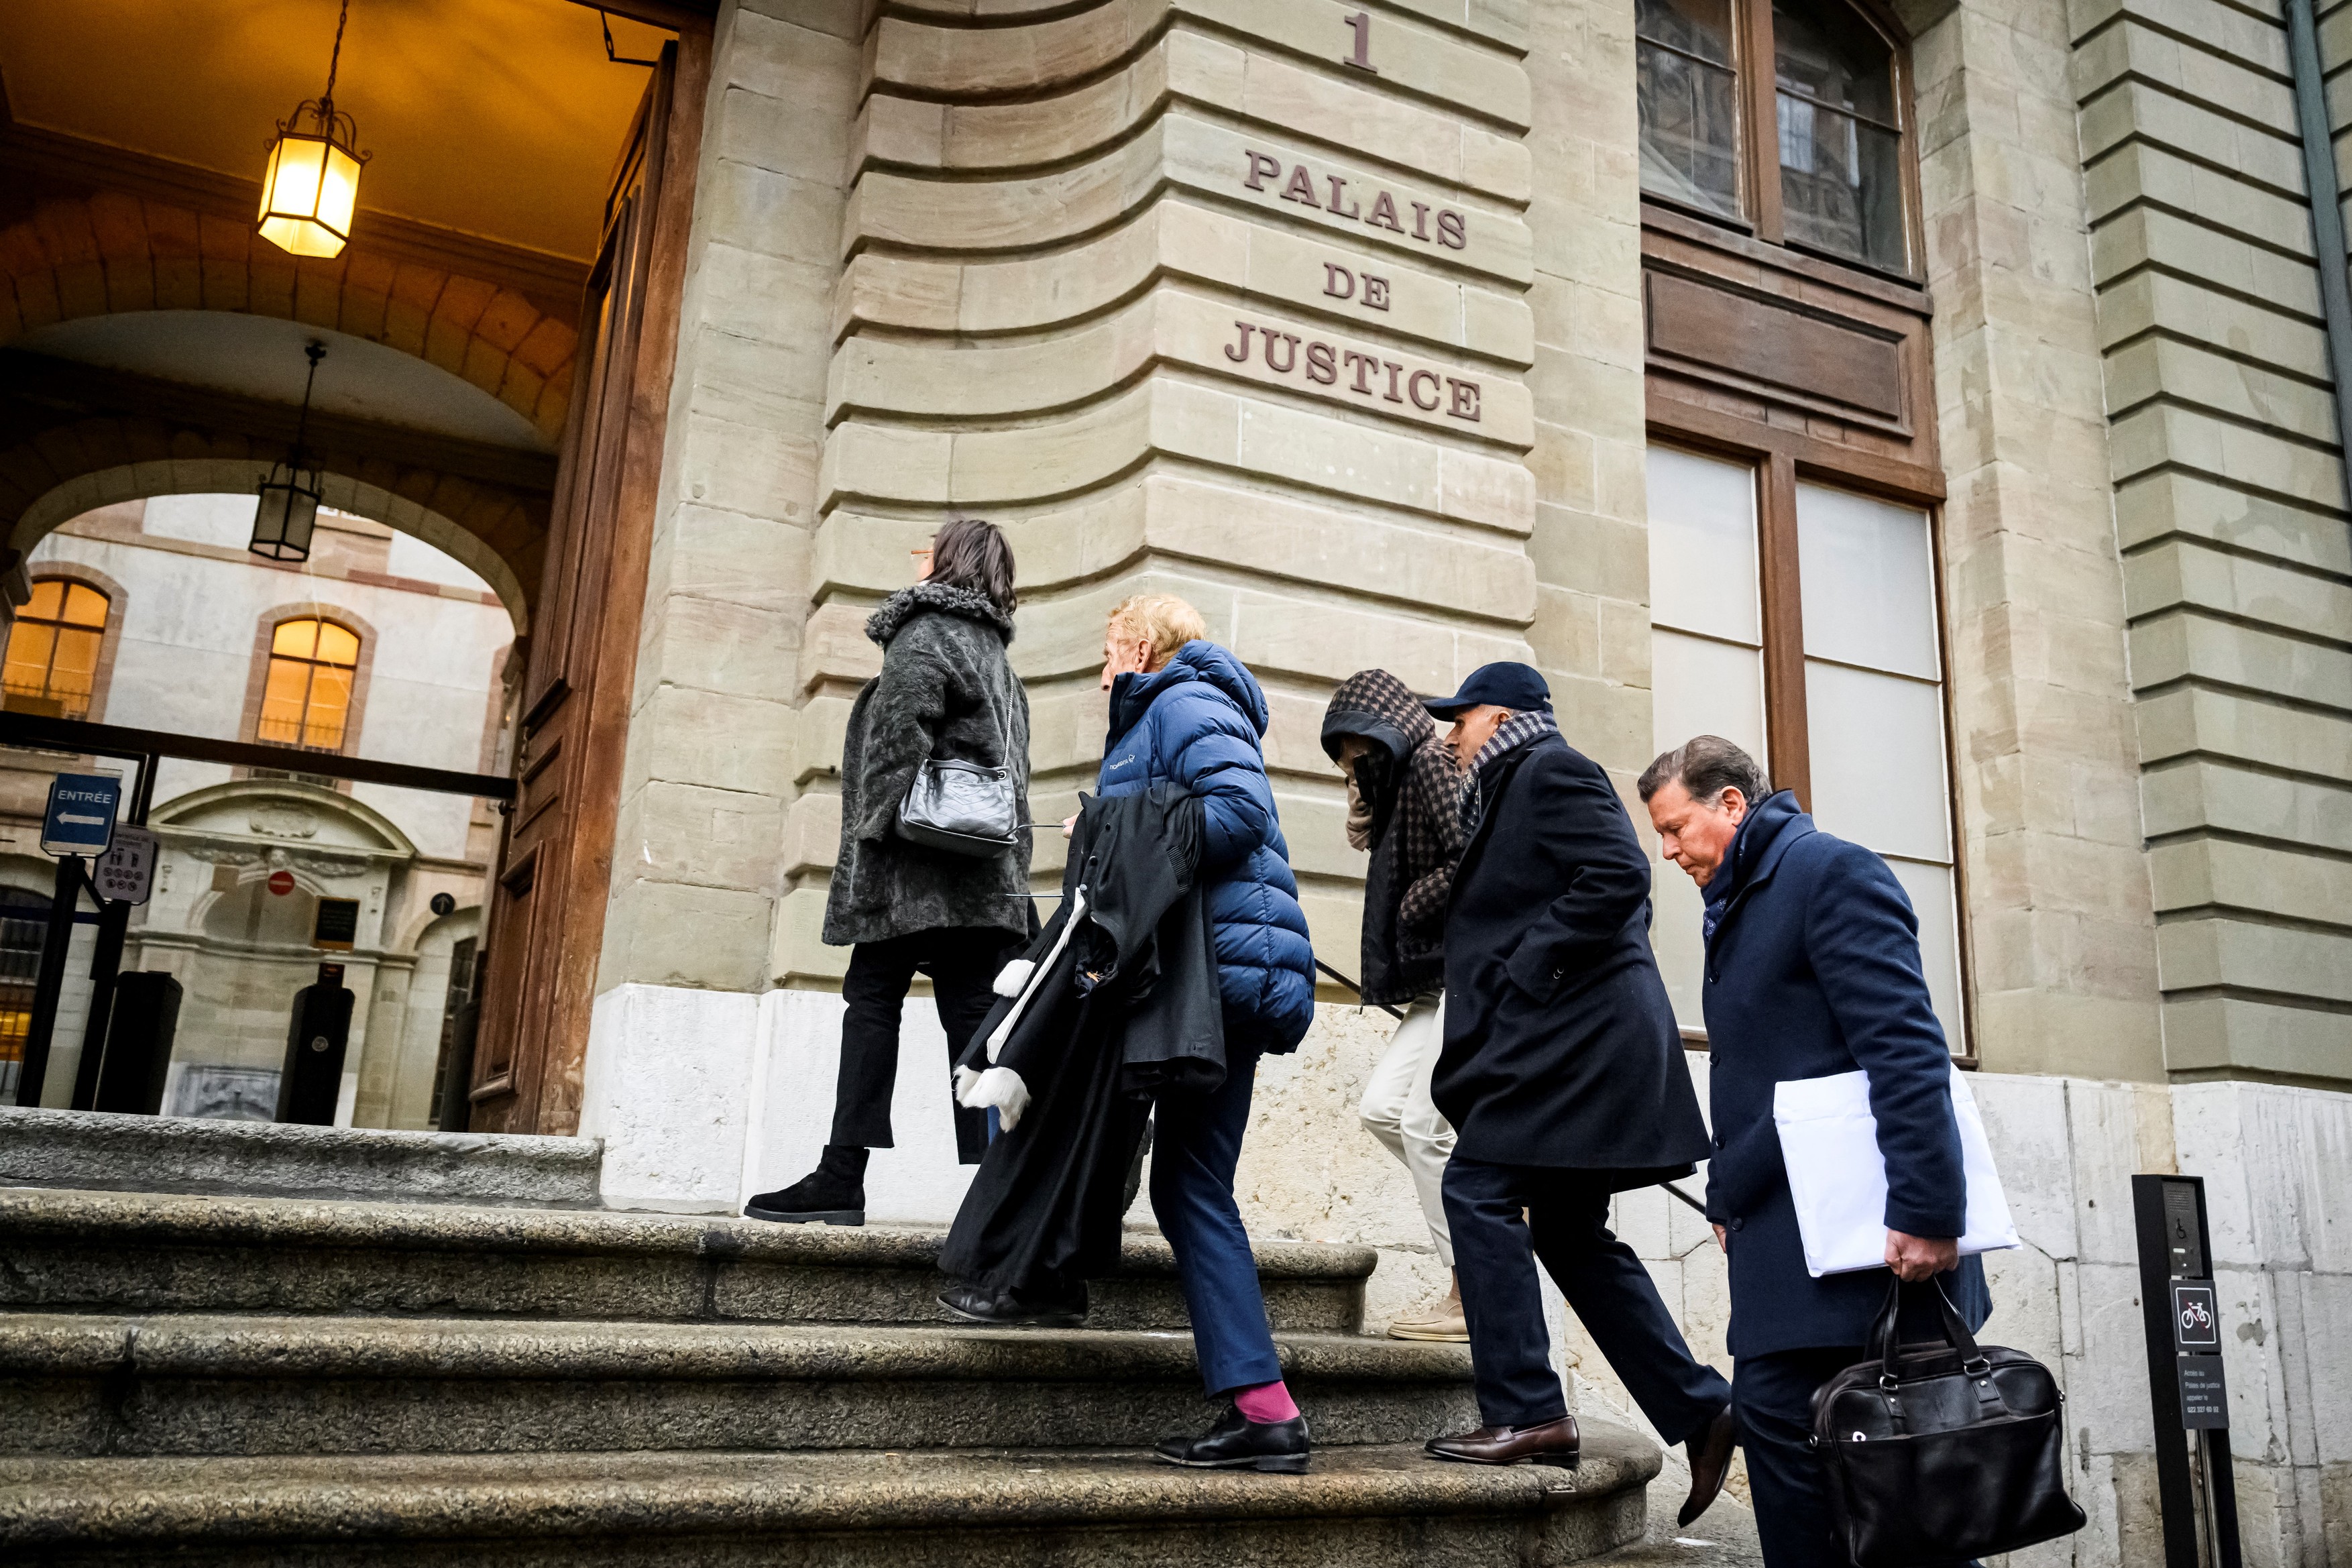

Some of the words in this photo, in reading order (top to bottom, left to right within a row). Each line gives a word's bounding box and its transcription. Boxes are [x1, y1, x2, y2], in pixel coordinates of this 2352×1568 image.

[1343, 13, 1377, 74] 1
[1244, 150, 1467, 250] PALAIS
[1323, 262, 1390, 311] DE
[1225, 321, 1480, 422] JUSTICE
[58, 790, 113, 804] ENTRÉE
